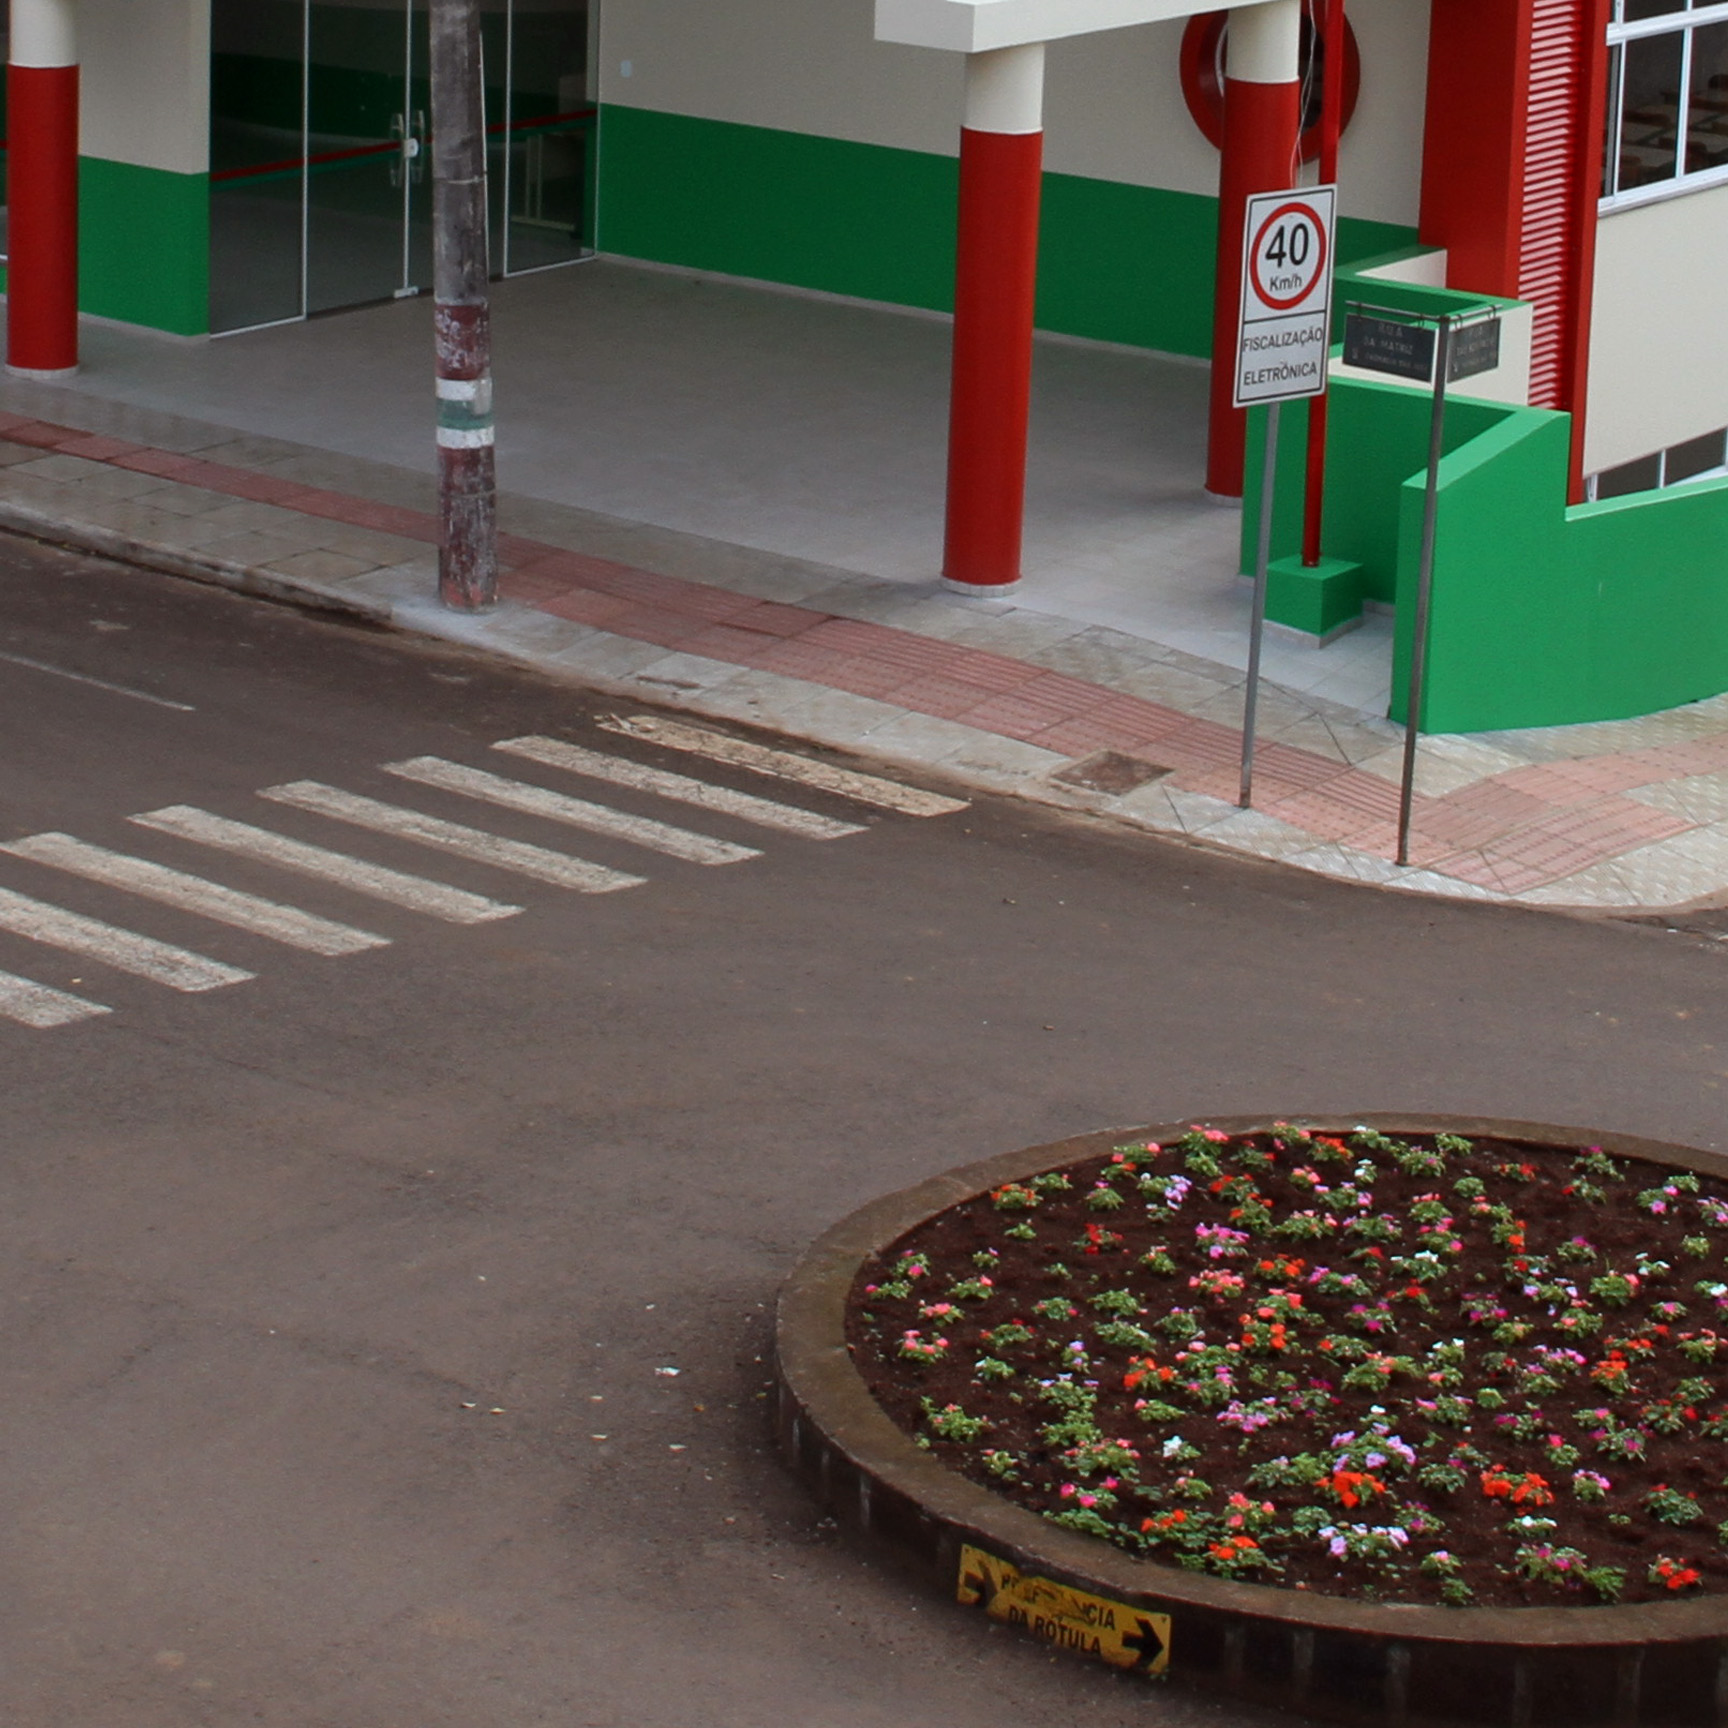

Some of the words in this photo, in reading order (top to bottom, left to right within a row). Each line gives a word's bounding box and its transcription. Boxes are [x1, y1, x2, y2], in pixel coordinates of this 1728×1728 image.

[1265, 222, 1309, 268] 40
[1269, 273, 1303, 292] Km/h
[1243, 326, 1323, 352] FISCALIZAÇÃO
[1243, 360, 1317, 386] ELETRÔNICA
[1008, 1604, 1029, 1626] DA
